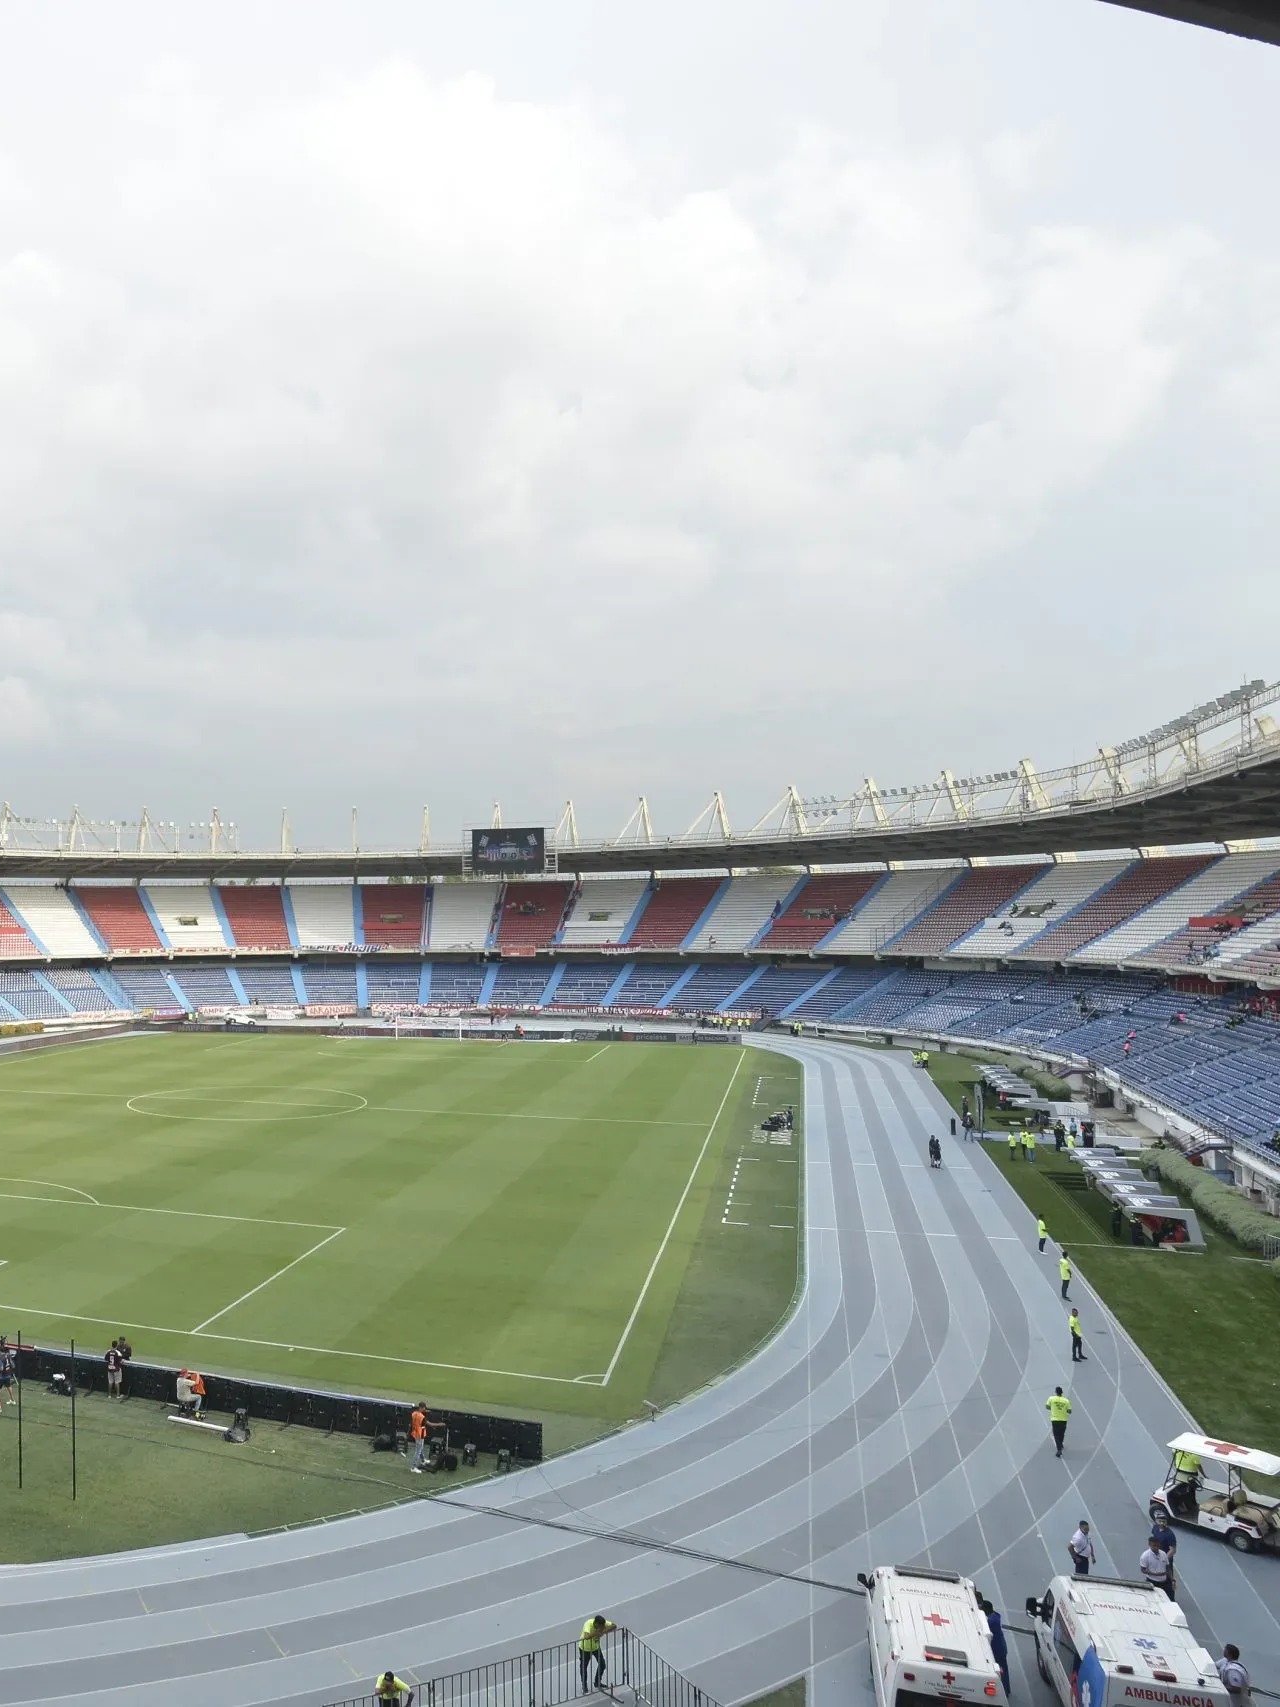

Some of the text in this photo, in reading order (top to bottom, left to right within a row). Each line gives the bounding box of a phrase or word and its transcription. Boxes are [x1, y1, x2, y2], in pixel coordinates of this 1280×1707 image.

[635, 1033, 668, 1043] priceless
[899, 1587, 962, 1600] AMBULANCIA
[1093, 1603, 1161, 1617] AMBULANCIA
[1125, 1686, 1215, 1707] AMBULANCIA
